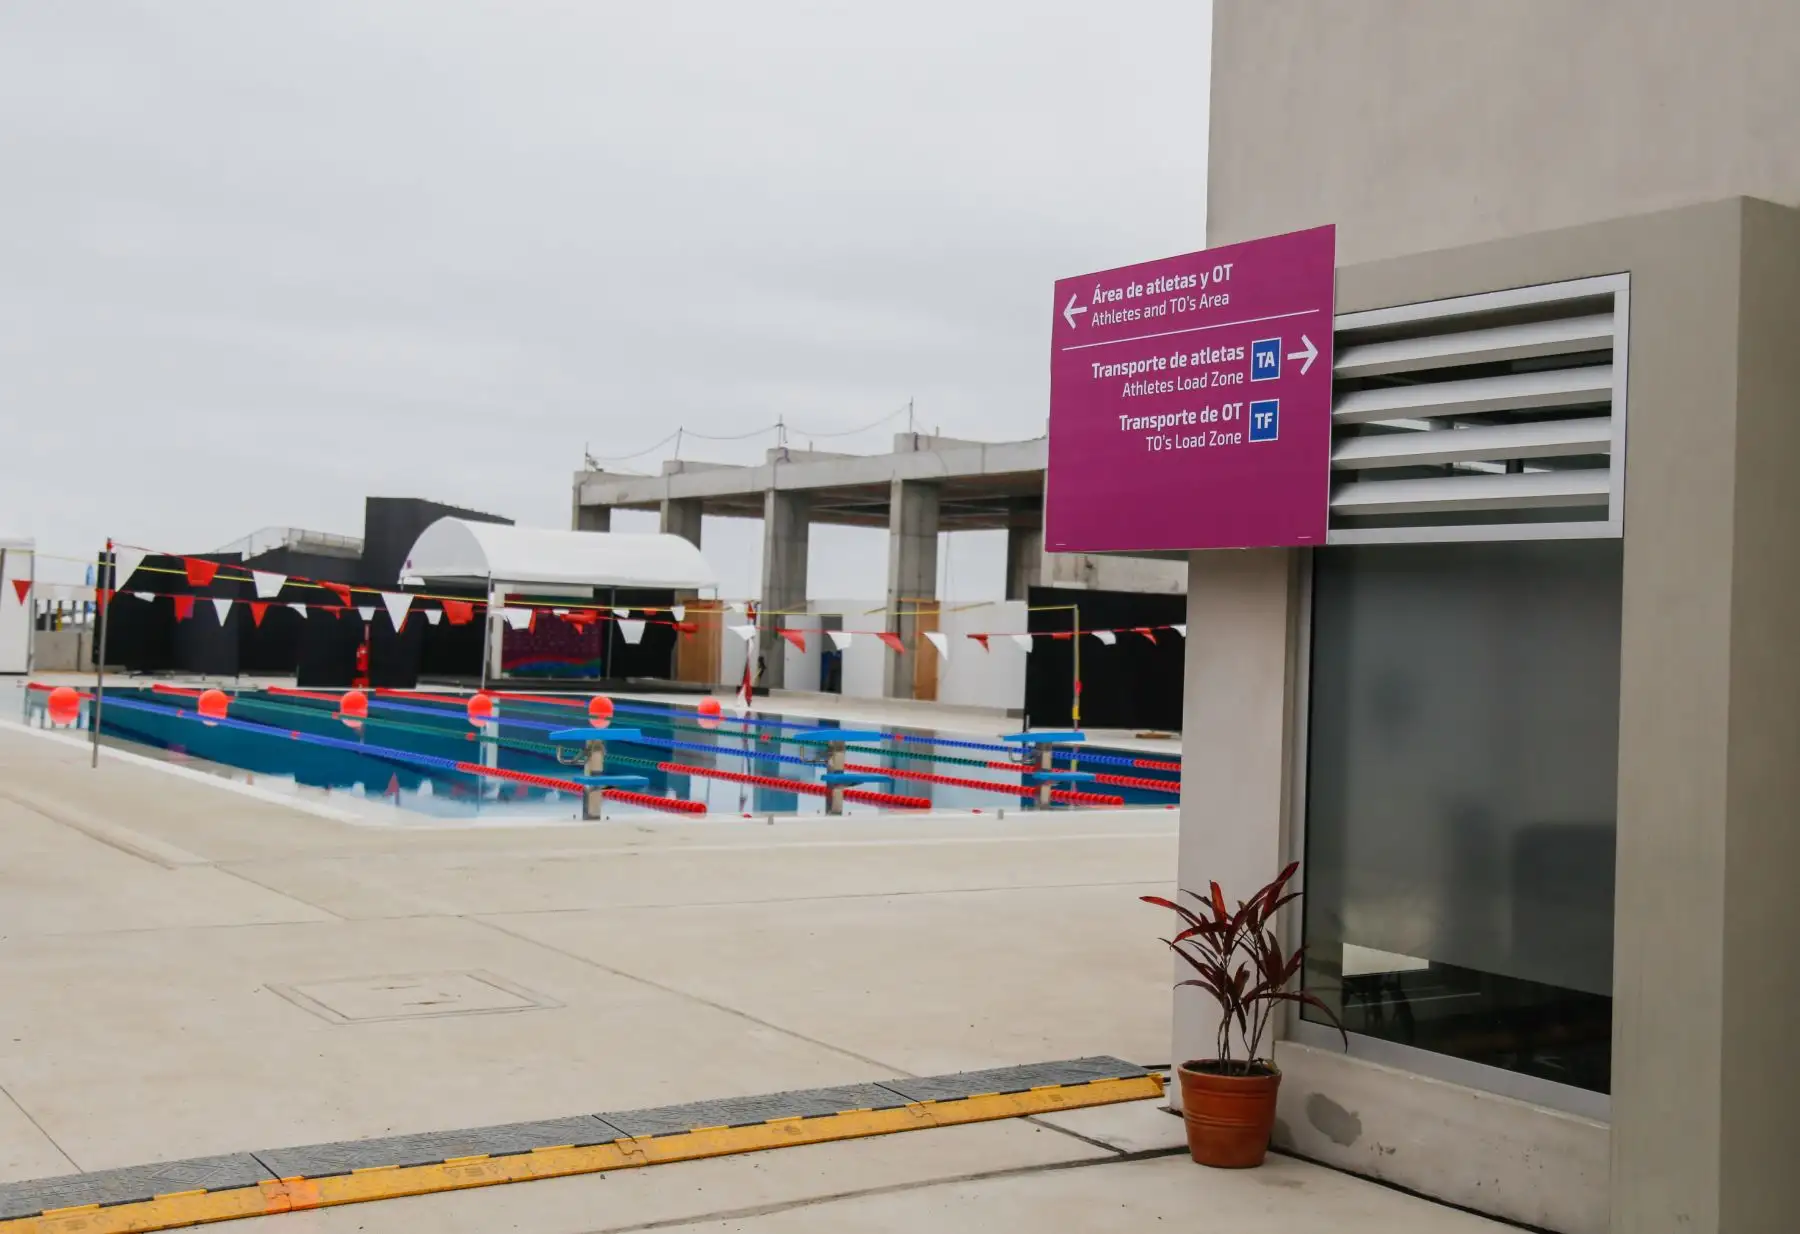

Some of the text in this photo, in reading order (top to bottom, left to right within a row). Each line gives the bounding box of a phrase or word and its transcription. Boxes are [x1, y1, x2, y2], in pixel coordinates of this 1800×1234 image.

[1091, 263, 1234, 305] Área de atletas y OT
[1091, 293, 1230, 327] Athletes and TO's Area
[1092, 345, 1245, 379] Transporte de atletas
[1256, 351, 1276, 369] TA
[1122, 371, 1244, 397] Athletes Load Zone
[1119, 402, 1244, 431] Transporte de OT
[1254, 412, 1274, 430] TF
[1146, 431, 1242, 452] TO's Load Zone
